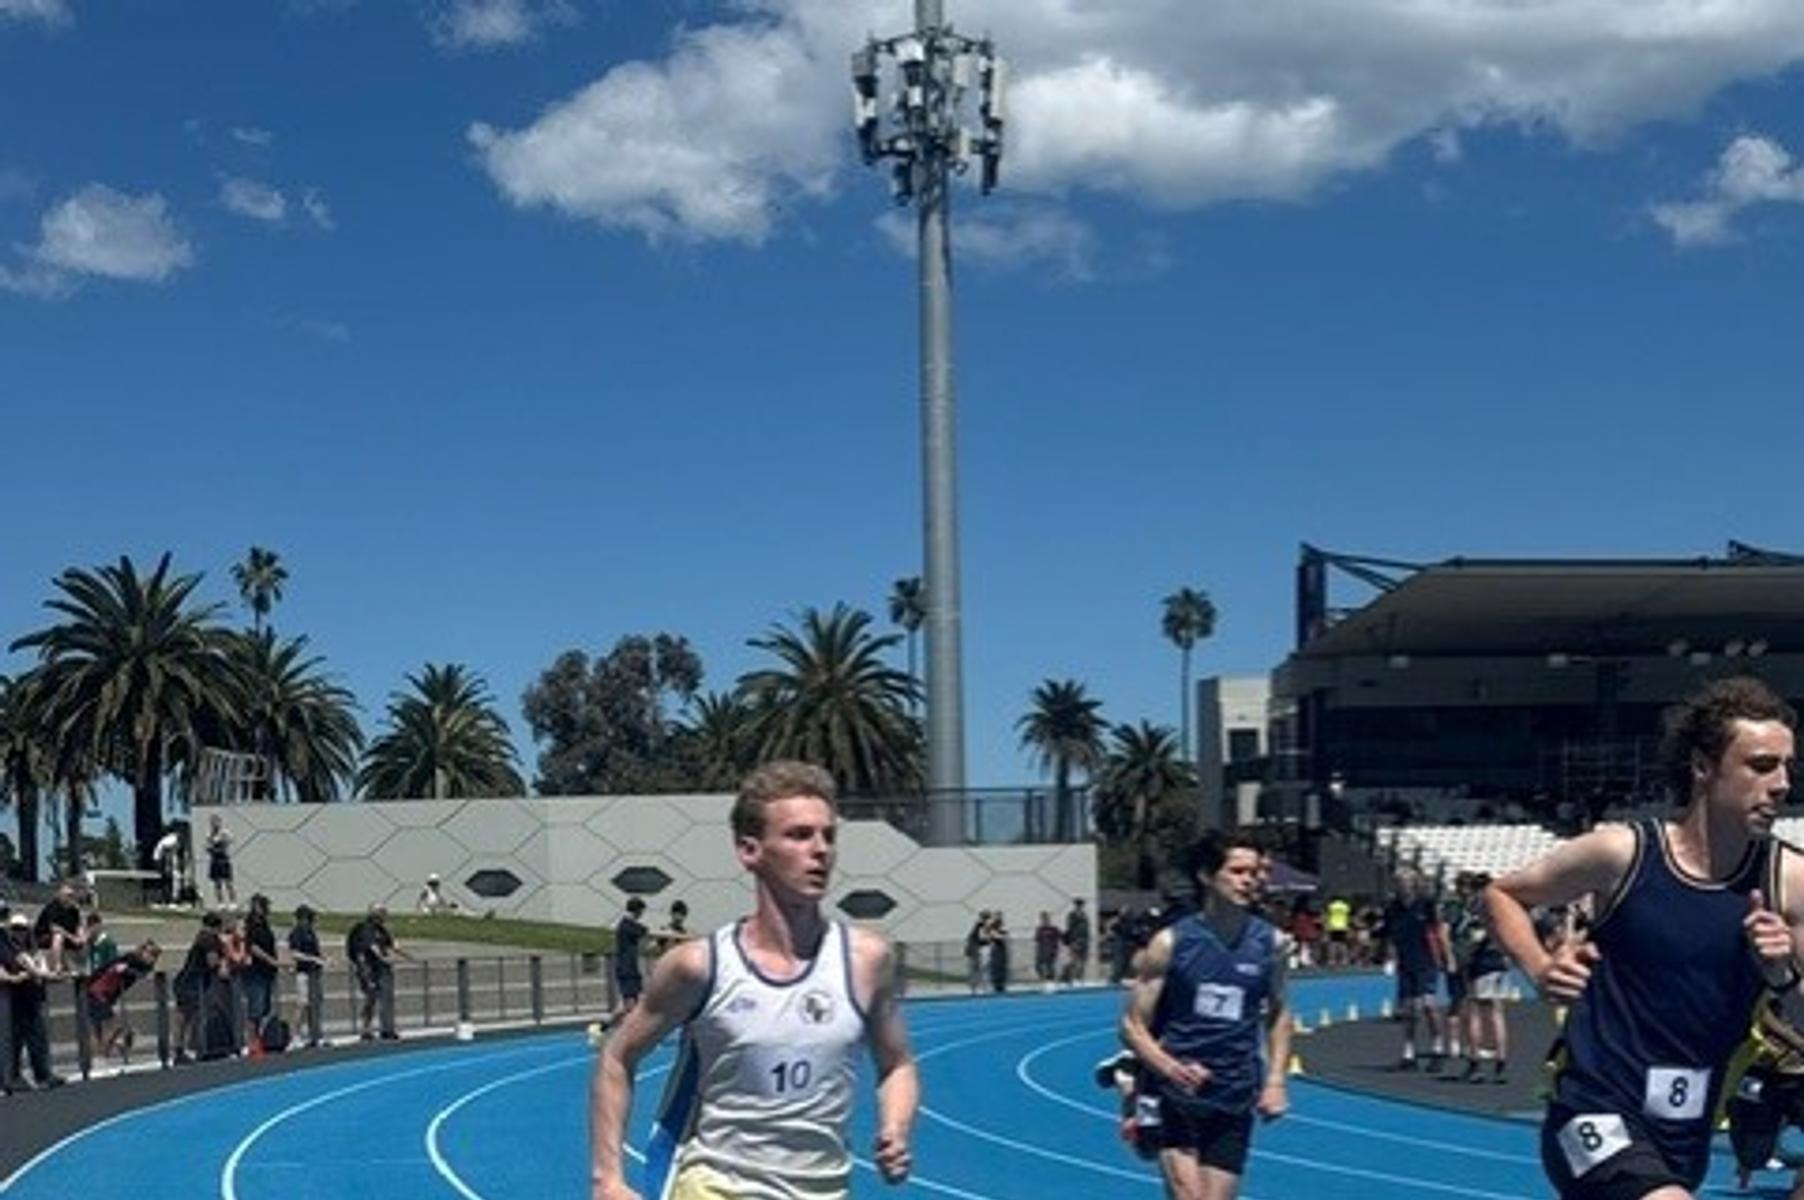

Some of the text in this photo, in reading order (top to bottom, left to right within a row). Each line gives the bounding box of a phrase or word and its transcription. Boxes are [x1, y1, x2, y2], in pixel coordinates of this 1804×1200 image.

[1213, 993, 1228, 1014] 7
[771, 1060, 811, 1093] 10
[1668, 1076, 1689, 1108] 8
[1578, 1121, 1603, 1152] 8
